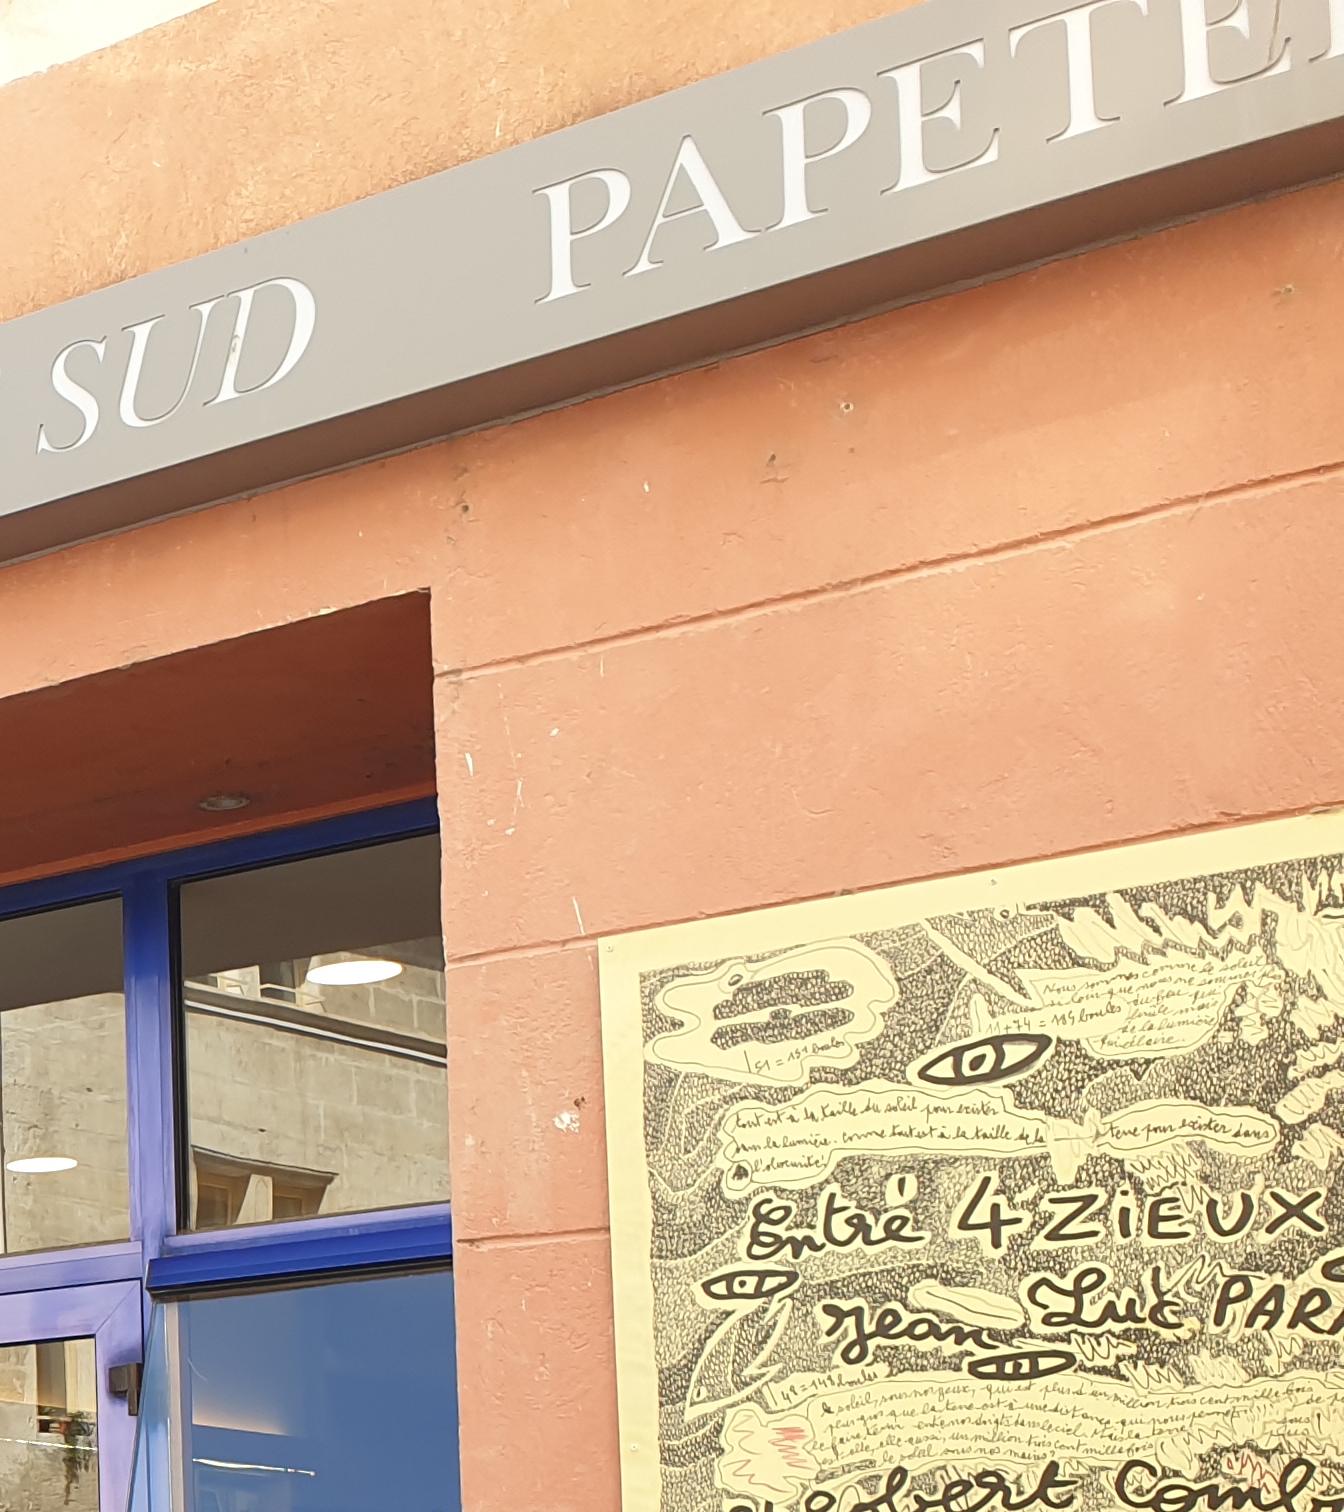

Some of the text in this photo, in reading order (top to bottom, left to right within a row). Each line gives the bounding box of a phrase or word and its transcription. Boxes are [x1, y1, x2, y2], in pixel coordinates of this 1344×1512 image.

[37, 275, 317, 455] SUD
[956, 1175, 1022, 1251] 4
[822, 1301, 999, 1365] Jean
